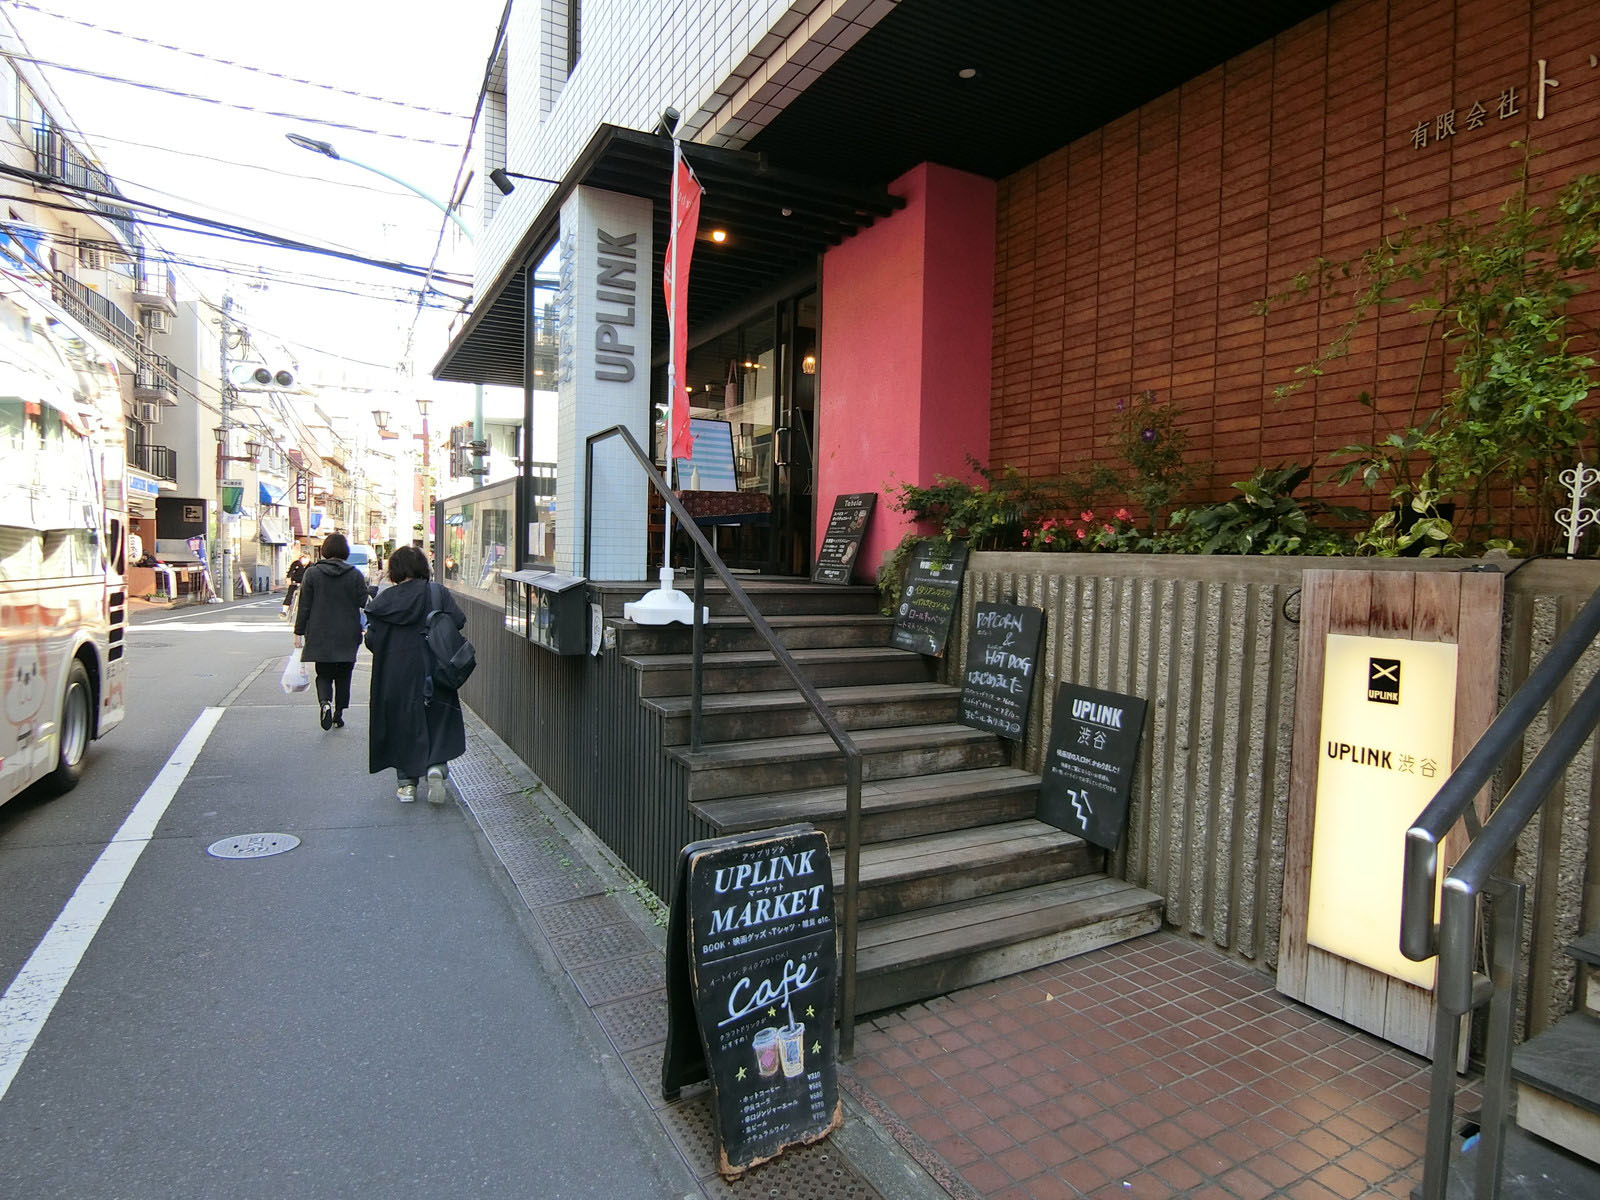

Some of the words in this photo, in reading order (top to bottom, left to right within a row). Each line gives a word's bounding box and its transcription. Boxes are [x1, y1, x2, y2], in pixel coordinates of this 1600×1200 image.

[1410, 87, 1519, 149] 有限会社
[595, 228, 637, 383] UPLINK
[976, 611, 1023, 632] POPCORN
[985, 650, 1008, 668] HOT
[1008, 654, 1031, 676] DOG
[968, 671, 1023, 694] はじめました
[1368, 689, 1398, 701] UPLINK
[1072, 699, 1123, 728] UPLINK
[1077, 726, 1107, 750] 渋谷
[1328, 741, 1392, 769] UPLINK
[1398, 753, 1437, 777] 渋谷
[714, 849, 816, 894] UPLINK
[748, 883, 784, 897] マーケット
[708, 885, 824, 936] MARKET
